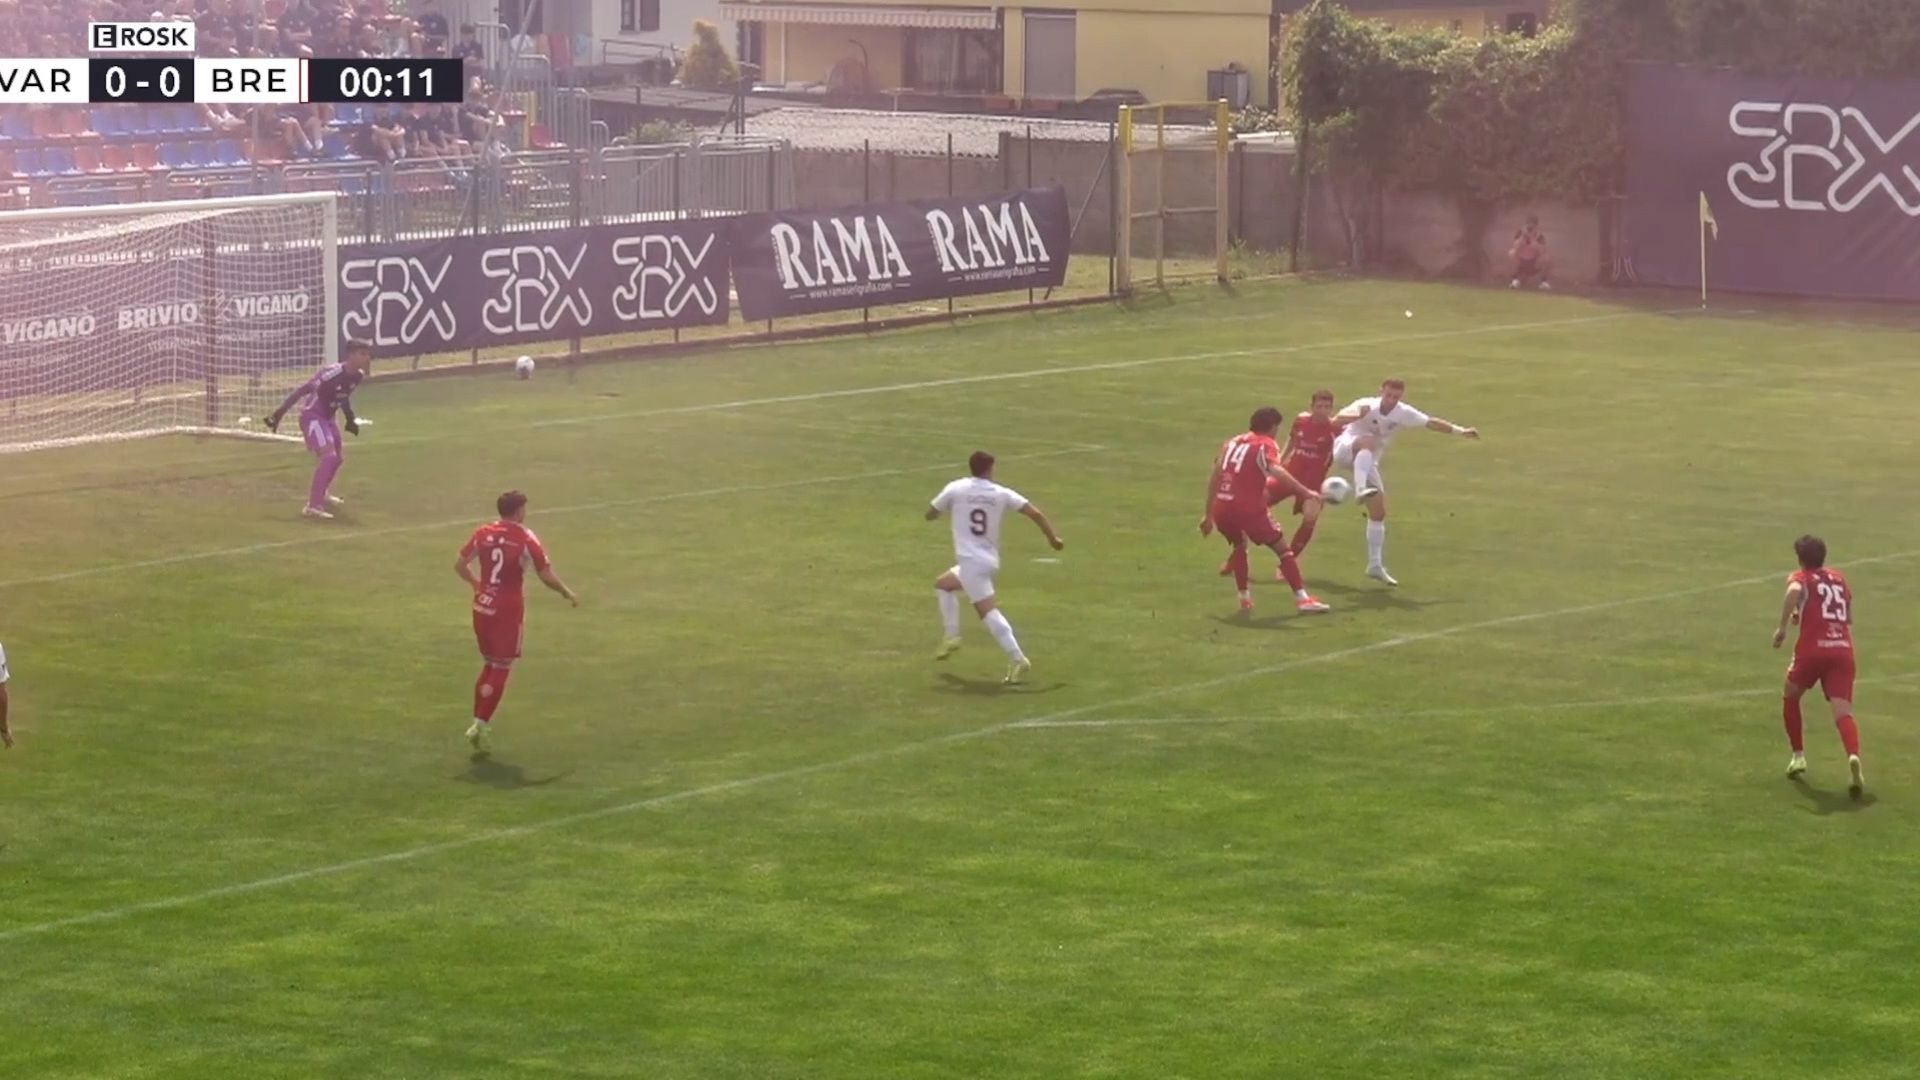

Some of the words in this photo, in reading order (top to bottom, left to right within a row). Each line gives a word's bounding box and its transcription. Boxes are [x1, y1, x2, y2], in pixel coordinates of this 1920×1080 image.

[771, 215, 911, 289] RAMA
[926, 201, 1050, 272] RAMA
[117, 303, 198, 330] BRIVIO
[1221, 442, 1250, 474] 14
[969, 508, 987, 536] 9
[490, 547, 504, 584] 2
[1817, 582, 1847, 622] 25
